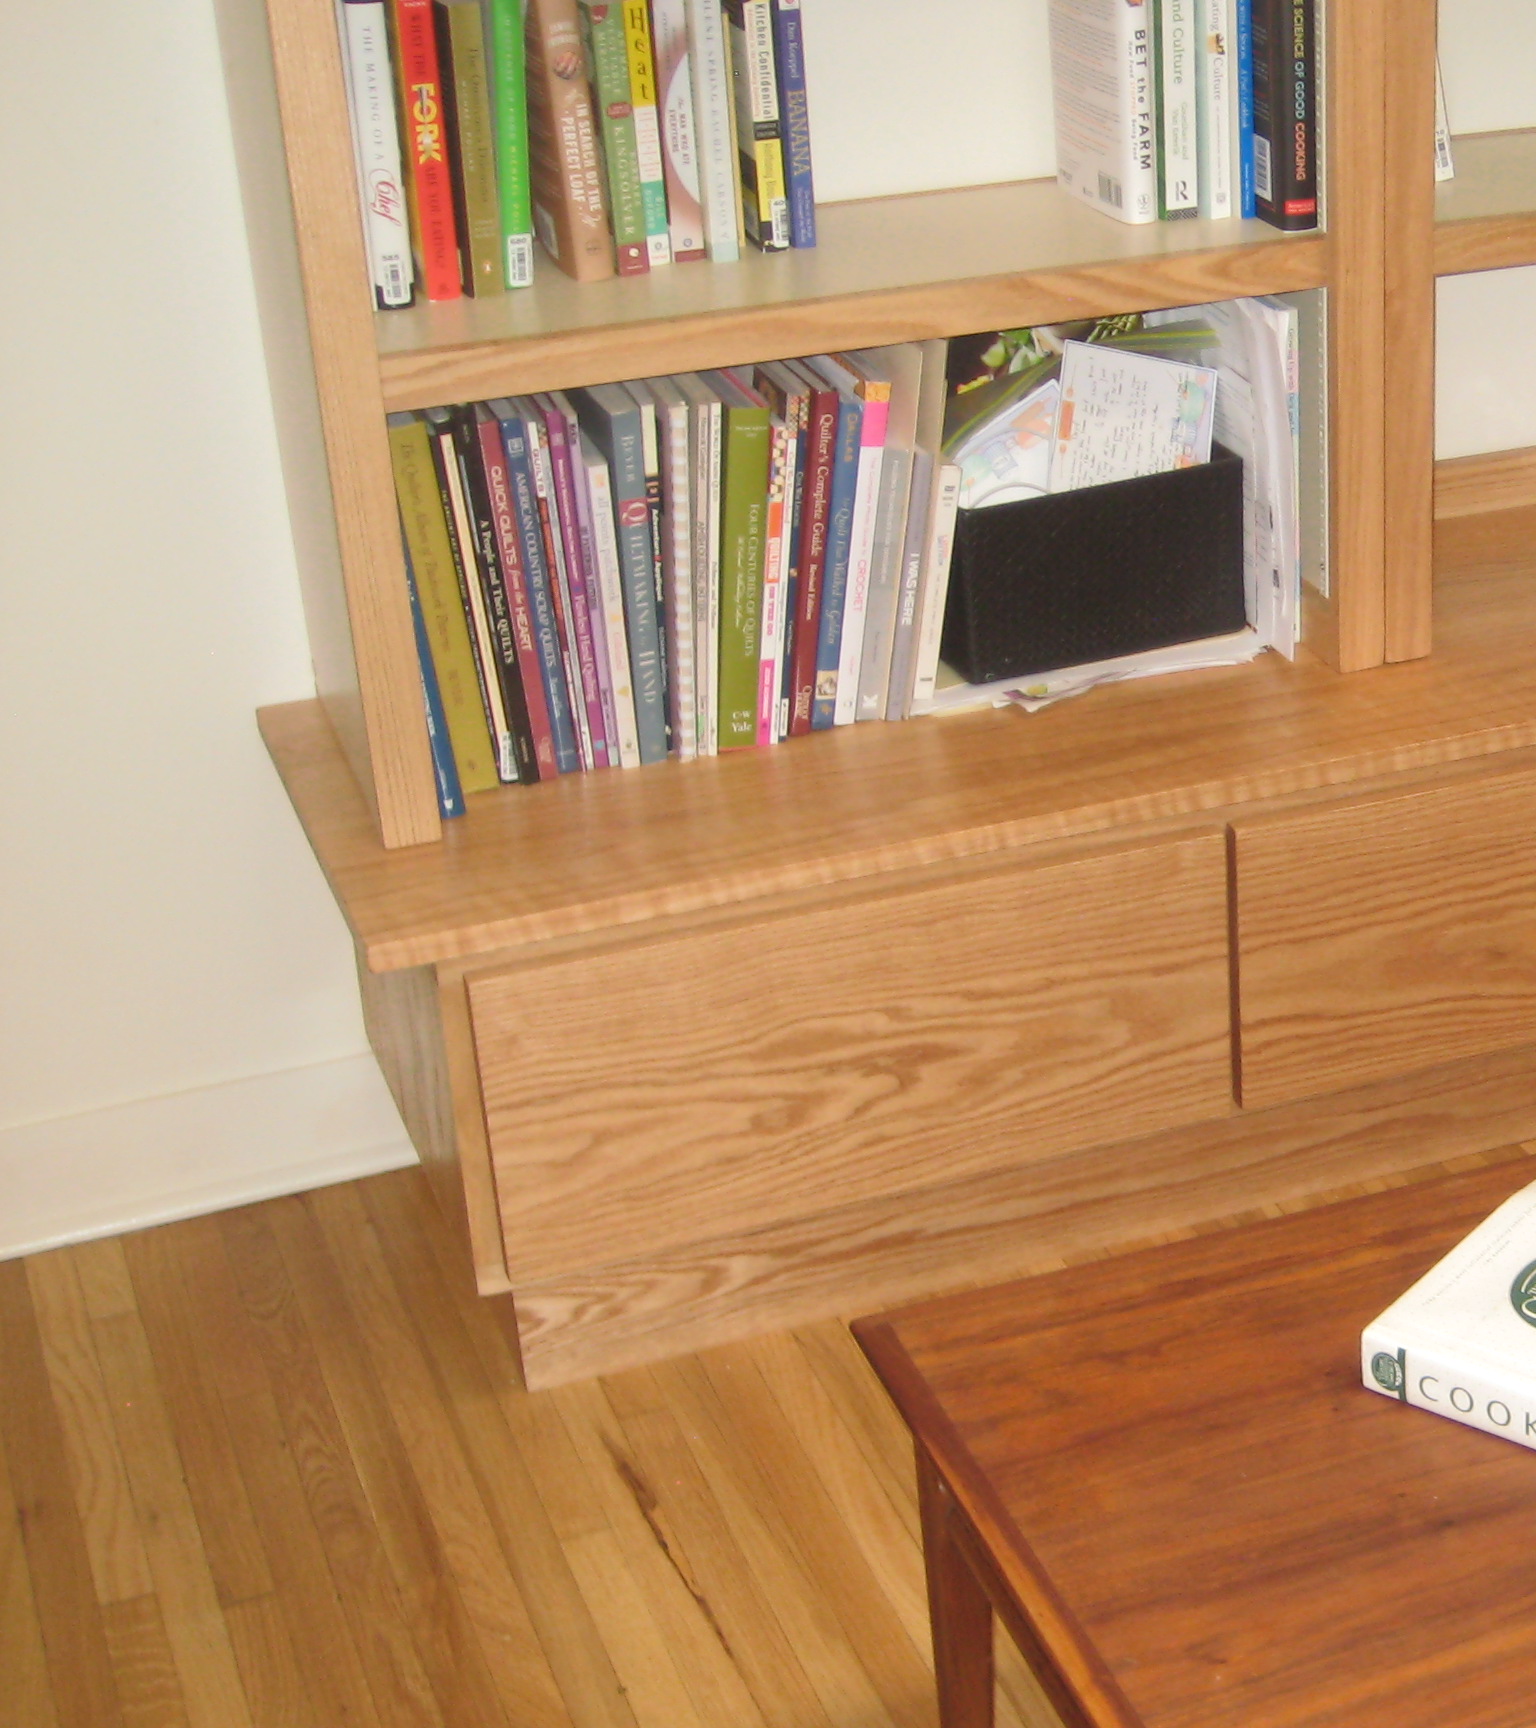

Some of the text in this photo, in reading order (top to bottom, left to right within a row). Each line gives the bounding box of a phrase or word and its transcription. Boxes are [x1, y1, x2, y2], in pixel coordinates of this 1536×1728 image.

[629, 6, 651, 98] Heat
[753, 3, 768, 42] Kitchen
[1171, 27, 1185, 84] Culture
[756, 50, 773, 118] Confidential
[1132, 27, 1154, 169] BET the FARM
[1211, 57, 1225, 100] Culture
[1290, 8, 1307, 180] SCIENCE OF GOOD COOKING
[360, 25, 402, 228] THE MAKING OF A Chef
[409, 81, 443, 164] FORK
[559, 114, 586, 203] PERFECT LOAF
[574, 101, 602, 210] IN SEARCH OF THE
[786, 87, 809, 174] BANANA
[611, 125, 634, 237] KINGSOLVER
[620, 434, 638, 481] BEYER
[844, 413, 857, 461] DALLAS
[490, 465, 508, 512] QUICK
[808, 412, 833, 556] Quilter's Complete Guide
[498, 514, 517, 565] QUILTS
[514, 471, 557, 667] AMERICAN COUNTRY SCRAP QUILTS
[595, 495, 619, 602] all points patchwork
[741, 503, 759, 656] FOUR CENTURIES OF QUILTS
[905, 558, 919, 588] WAS
[477, 518, 514, 664] A People and Their QUILTS
[620, 500, 660, 703] QUILTMAKING HAND
[805, 563, 817, 620] Revised Edition
[853, 559, 867, 612] CROCHET
[902, 589, 916, 625] HERE
[513, 606, 532, 651] HEART
[731, 719, 753, 733] Yale
